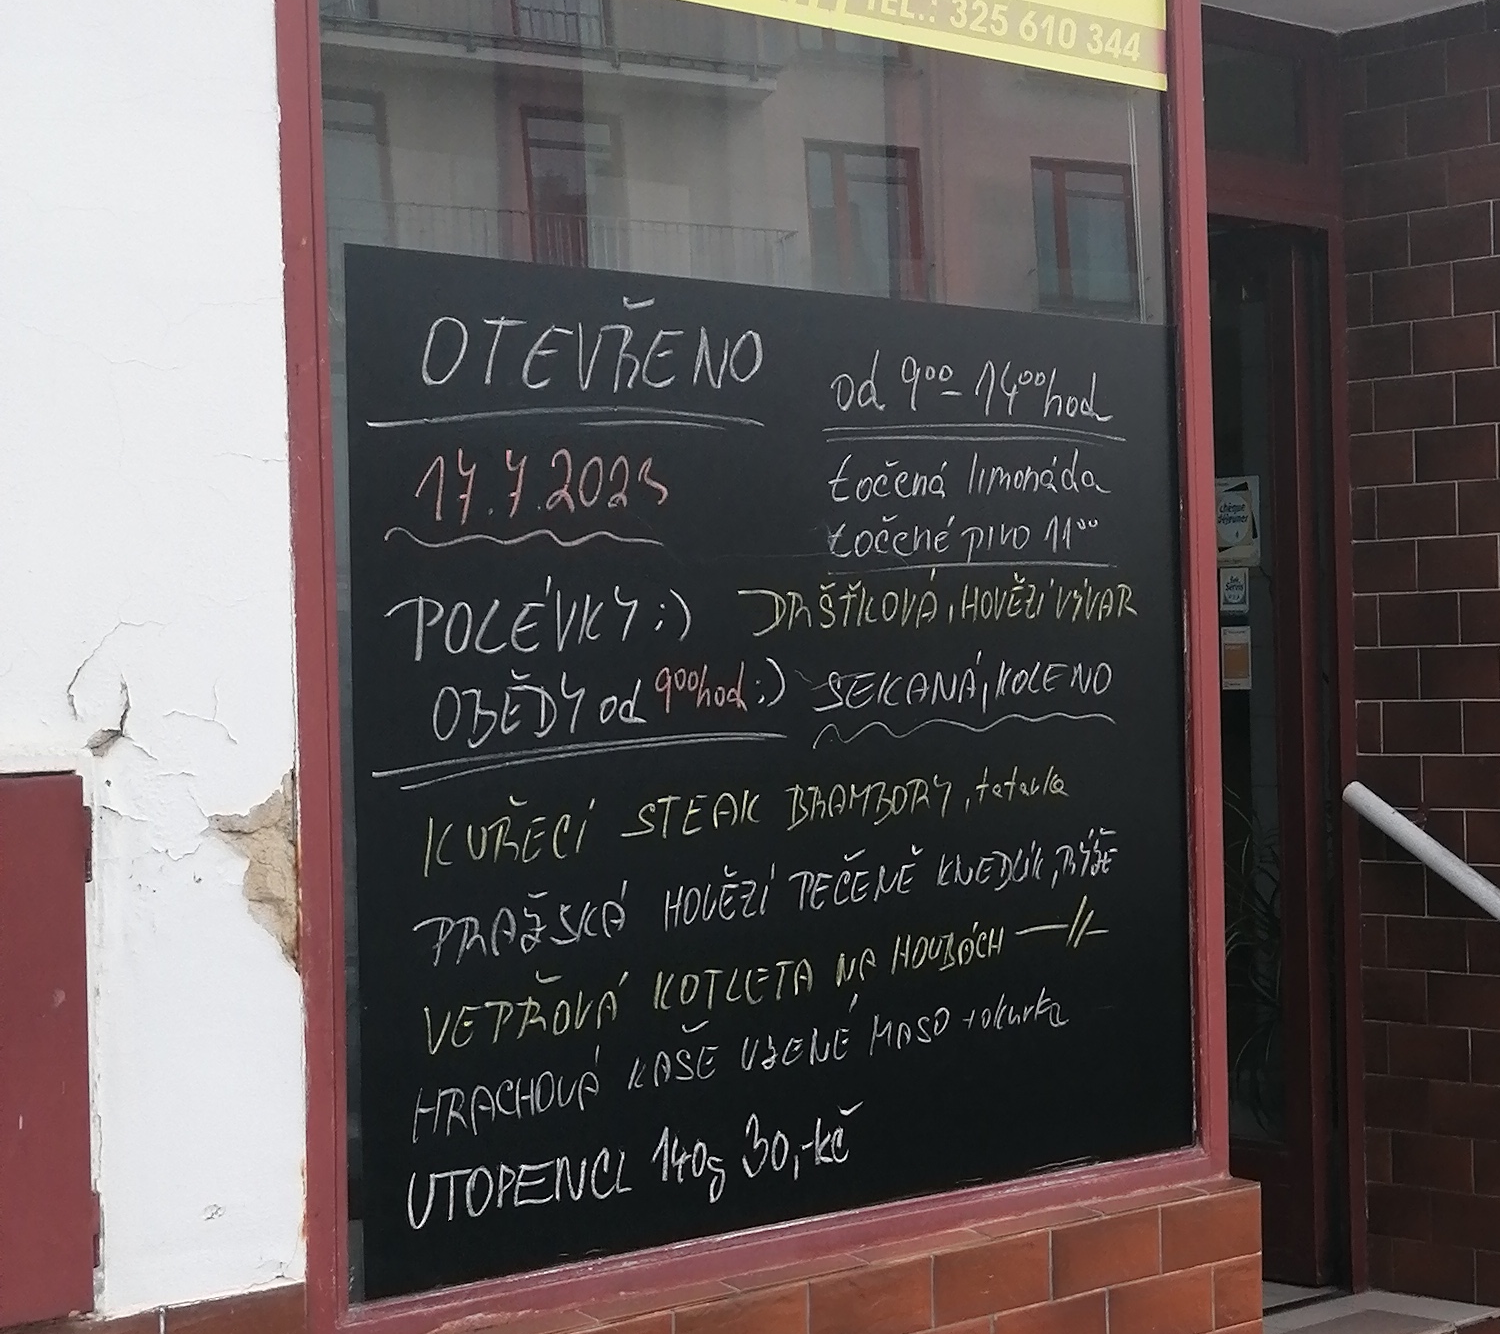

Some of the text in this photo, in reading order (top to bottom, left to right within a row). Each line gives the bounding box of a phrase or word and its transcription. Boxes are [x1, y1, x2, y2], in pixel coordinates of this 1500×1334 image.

[1020, 9, 1077, 51] 610
[1086, 23, 1141, 62] 344
[421, 294, 764, 393] OTEVŘENO
[828, 447, 1112, 503] točená limonáda
[828, 514, 956, 558] točené
[961, 523, 1033, 564] pivo
[383, 574, 639, 662] POLÉVKY
[432, 668, 586, 749] OBĚDY
[599, 678, 648, 725] od
[994, 660, 1114, 700] KOLENO
[423, 795, 597, 878] KUŘECÍ
[620, 788, 763, 839] STEAK
[412, 879, 628, 967] PRAŽSKÁ
[664, 862, 777, 933] HOVĚZÍ
[654, 957, 815, 1011] KOTLETA
[835, 947, 878, 989] NA
[412, 1044, 600, 1145] HRACHOVÁ
[627, 1019, 720, 1091] KAŠE
[741, 993, 860, 1071] UZENÉ
[869, 1006, 951, 1057] MASO
[651, 1125, 726, 1205] 140g
